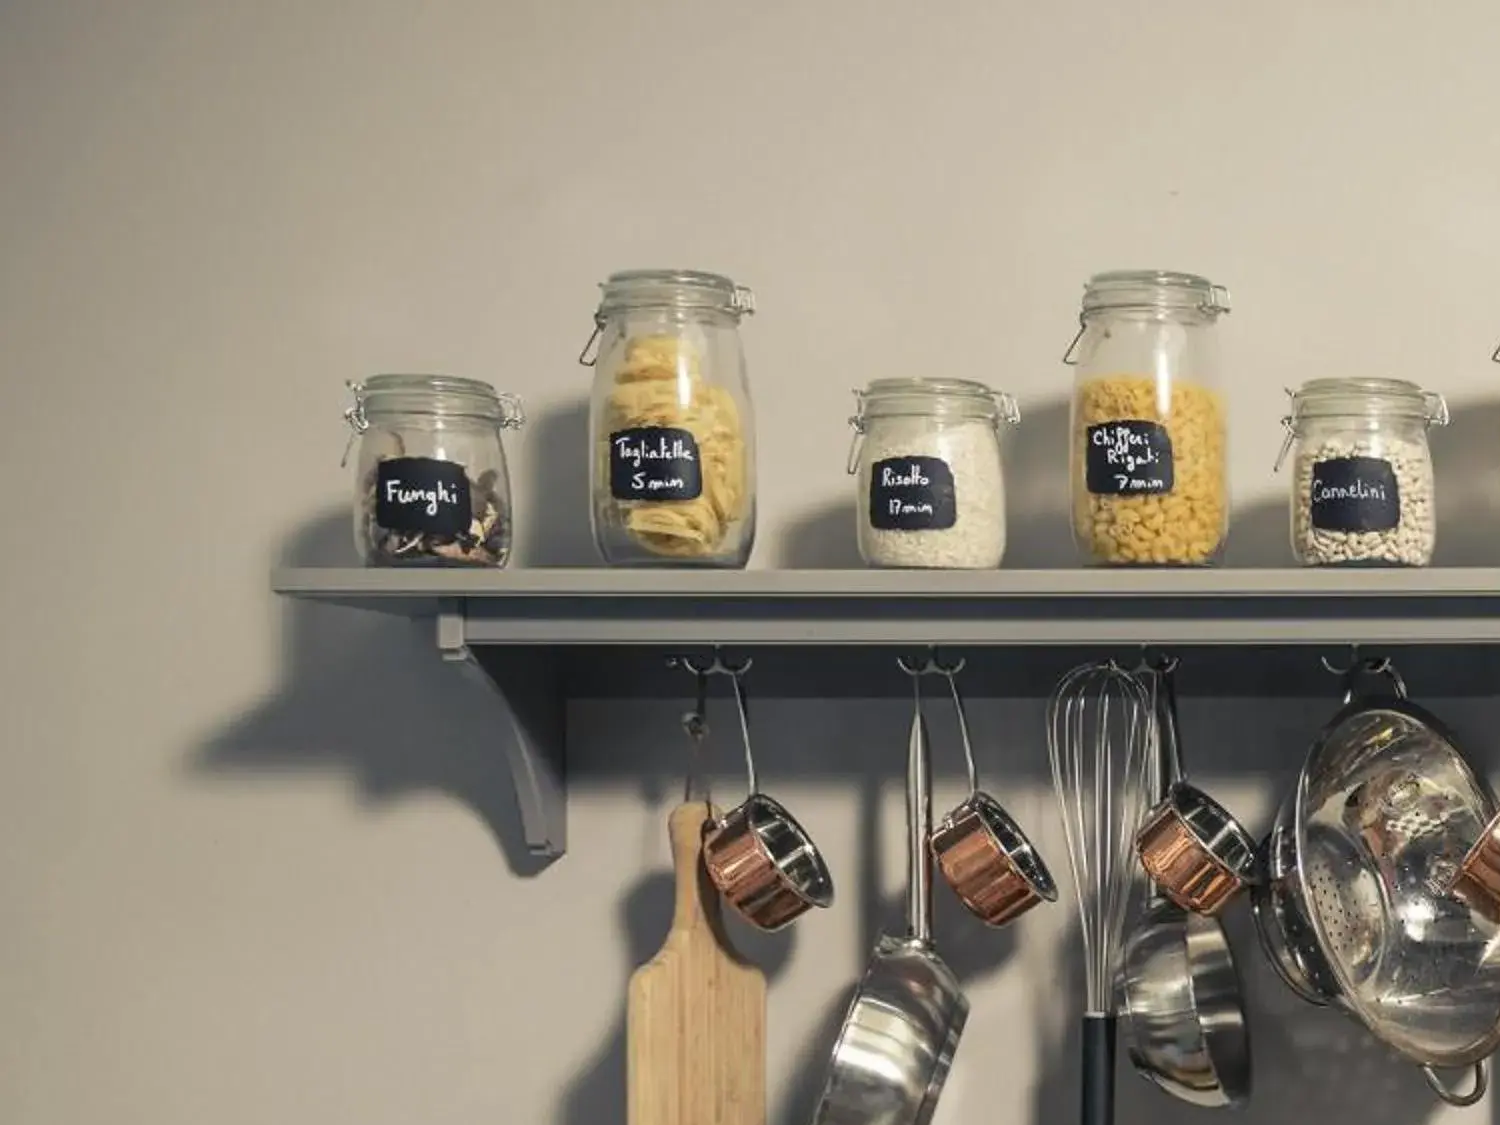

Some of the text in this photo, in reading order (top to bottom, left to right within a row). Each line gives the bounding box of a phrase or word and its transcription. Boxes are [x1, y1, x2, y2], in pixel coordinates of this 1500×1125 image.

[615, 437, 694, 468] Tagliatelle
[1093, 426, 1149, 455] Chifferi
[1106, 447, 1161, 472] Rigati
[882, 464, 929, 487] Risotto
[386, 479, 457, 516] Funghi
